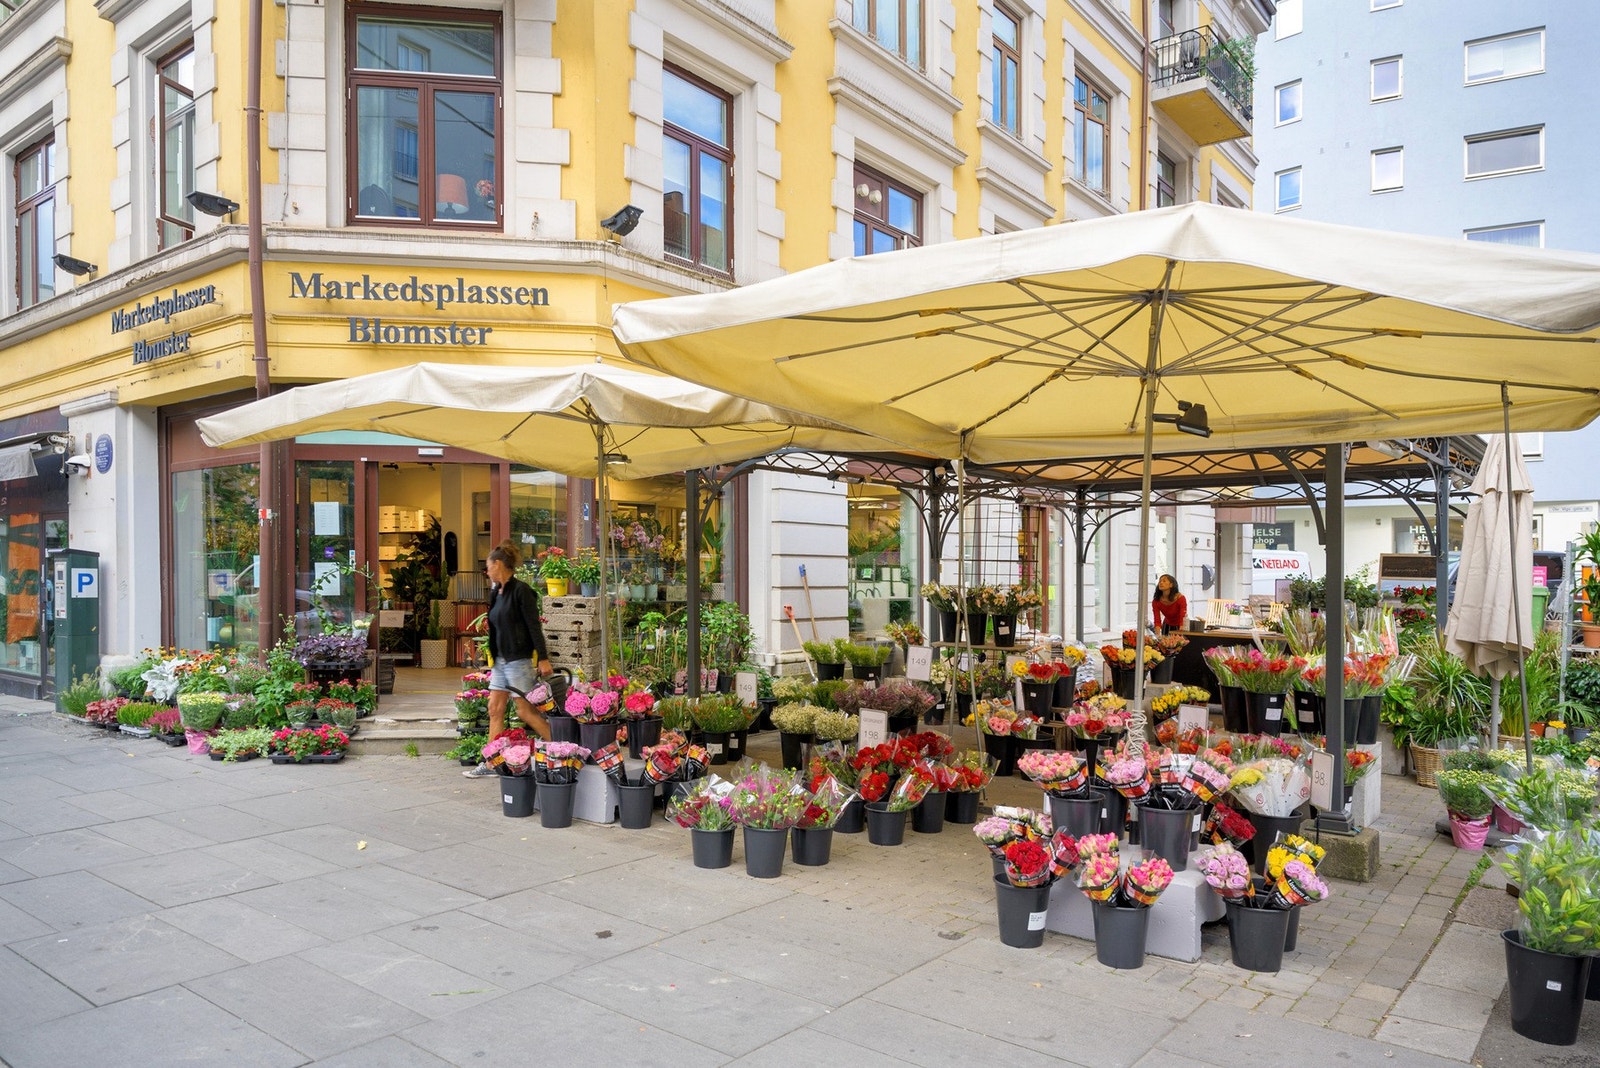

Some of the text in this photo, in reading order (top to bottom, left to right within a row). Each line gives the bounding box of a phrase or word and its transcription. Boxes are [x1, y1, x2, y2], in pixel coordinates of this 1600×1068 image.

[288, 272, 549, 310] Markedsplassen
[111, 284, 216, 335] Markedsplassen
[347, 317, 493, 346] Blomster
[132, 331, 192, 366] Blomster
[1254, 537, 1275, 545] shop
[1262, 559, 1300, 569] NETELAND
[77, 573, 94, 593] P
[911, 657, 927, 666] 149
[864, 730, 879, 740] 198
